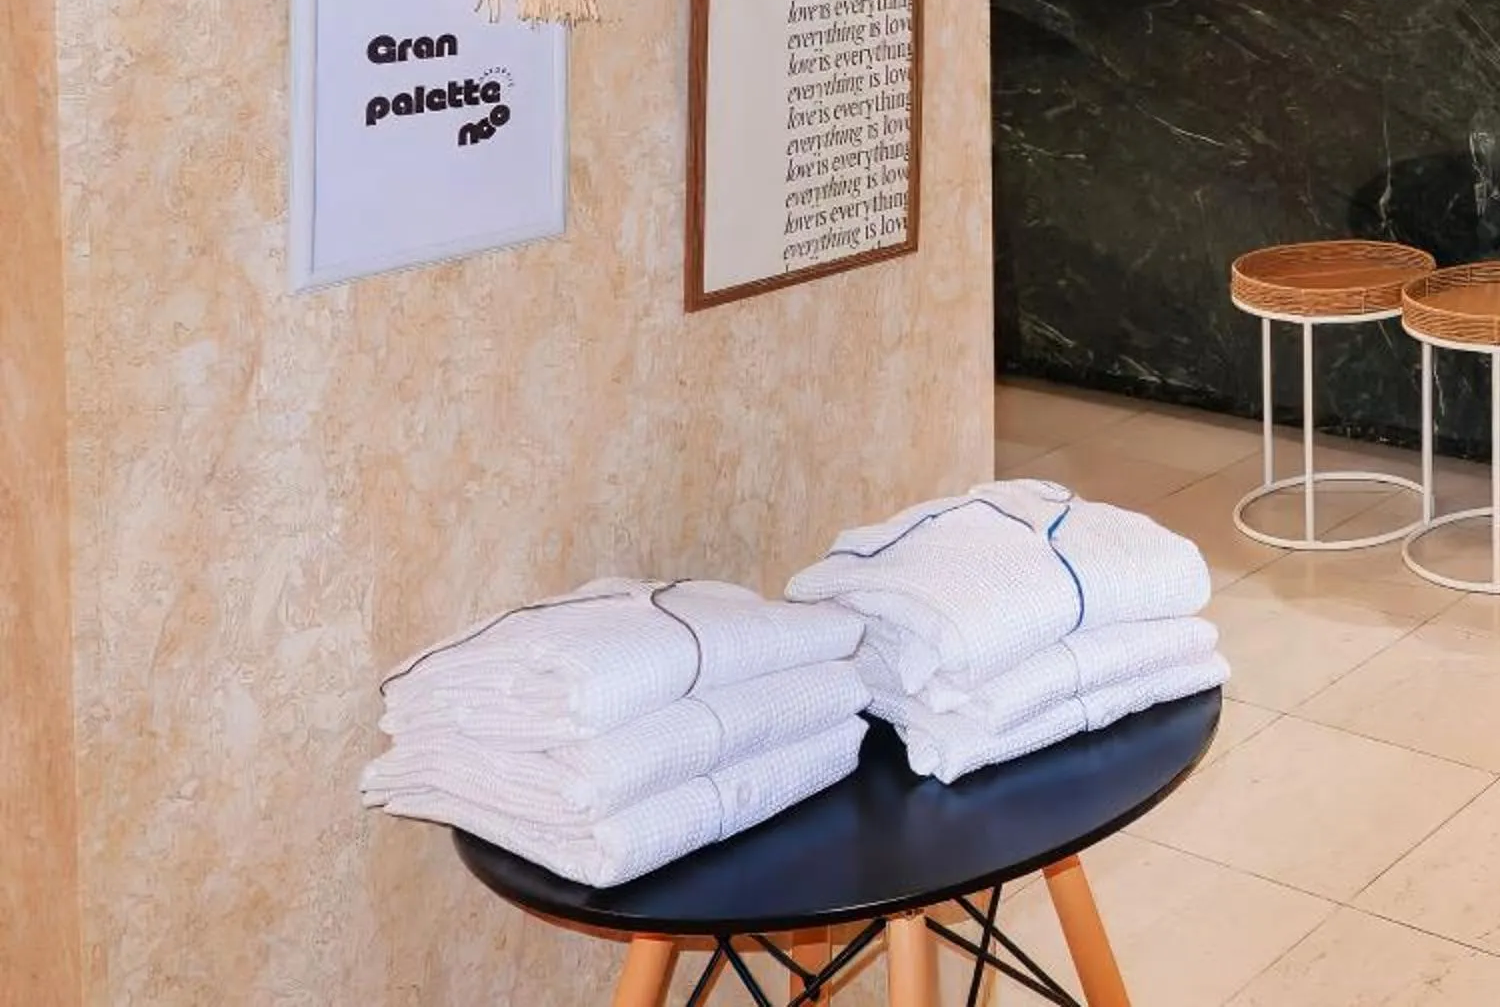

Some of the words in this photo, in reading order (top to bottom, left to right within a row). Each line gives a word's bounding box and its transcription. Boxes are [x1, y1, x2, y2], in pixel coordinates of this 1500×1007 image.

[869, 19, 881, 37] is
[885, 14, 912, 35] lov
[367, 33, 458, 64] Gran
[820, 51, 831, 71] is
[869, 71, 881, 88] is
[366, 79, 500, 126] palette
[819, 102, 830, 124] is
[458, 104, 511, 146] neo
[868, 123, 878, 139] is
[883, 114, 910, 135] lov
[817, 154, 828, 175] is
[867, 173, 878, 189] is
[882, 164, 908, 185] lov
[815, 209, 826, 227] is
[865, 222, 876, 240] is
[881, 214, 907, 235] lov
